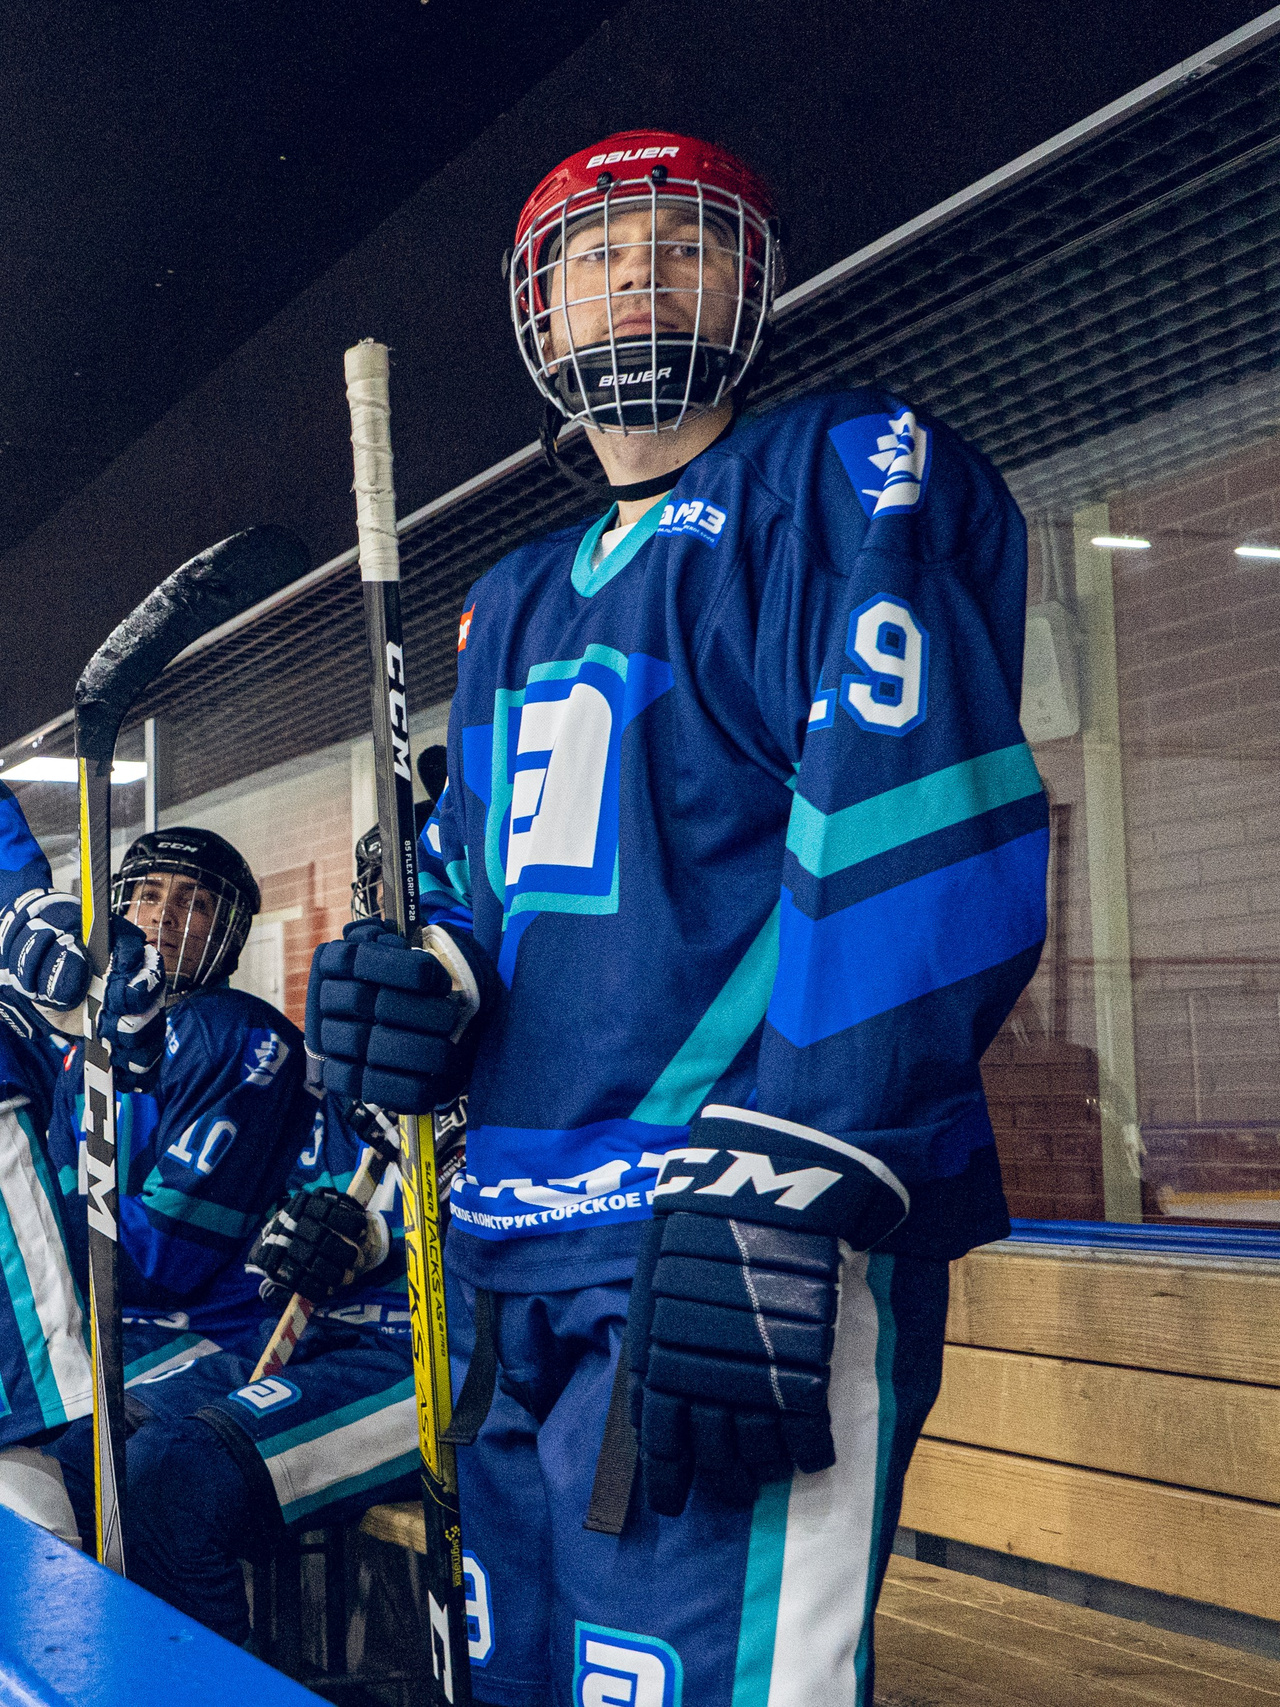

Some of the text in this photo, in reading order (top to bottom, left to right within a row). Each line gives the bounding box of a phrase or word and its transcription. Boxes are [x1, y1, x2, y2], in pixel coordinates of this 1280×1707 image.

[586, 146, 680, 169] BAUER
[598, 366, 672, 388] BAUER
[385, 640, 412, 782] CCM
[157, 841, 199, 853] CCM
[404, 840, 412, 852] 85
[405, 853, 414, 875] FLEX
[407, 876, 415, 897] GRIP
[167, 1118, 237, 1175] 10
[424, 1160, 435, 1212] SUPER
[471, 1192, 642, 1230] КОНСТРУКТОРСКОЕ
[452, 1538, 462, 1588] sigmatex
